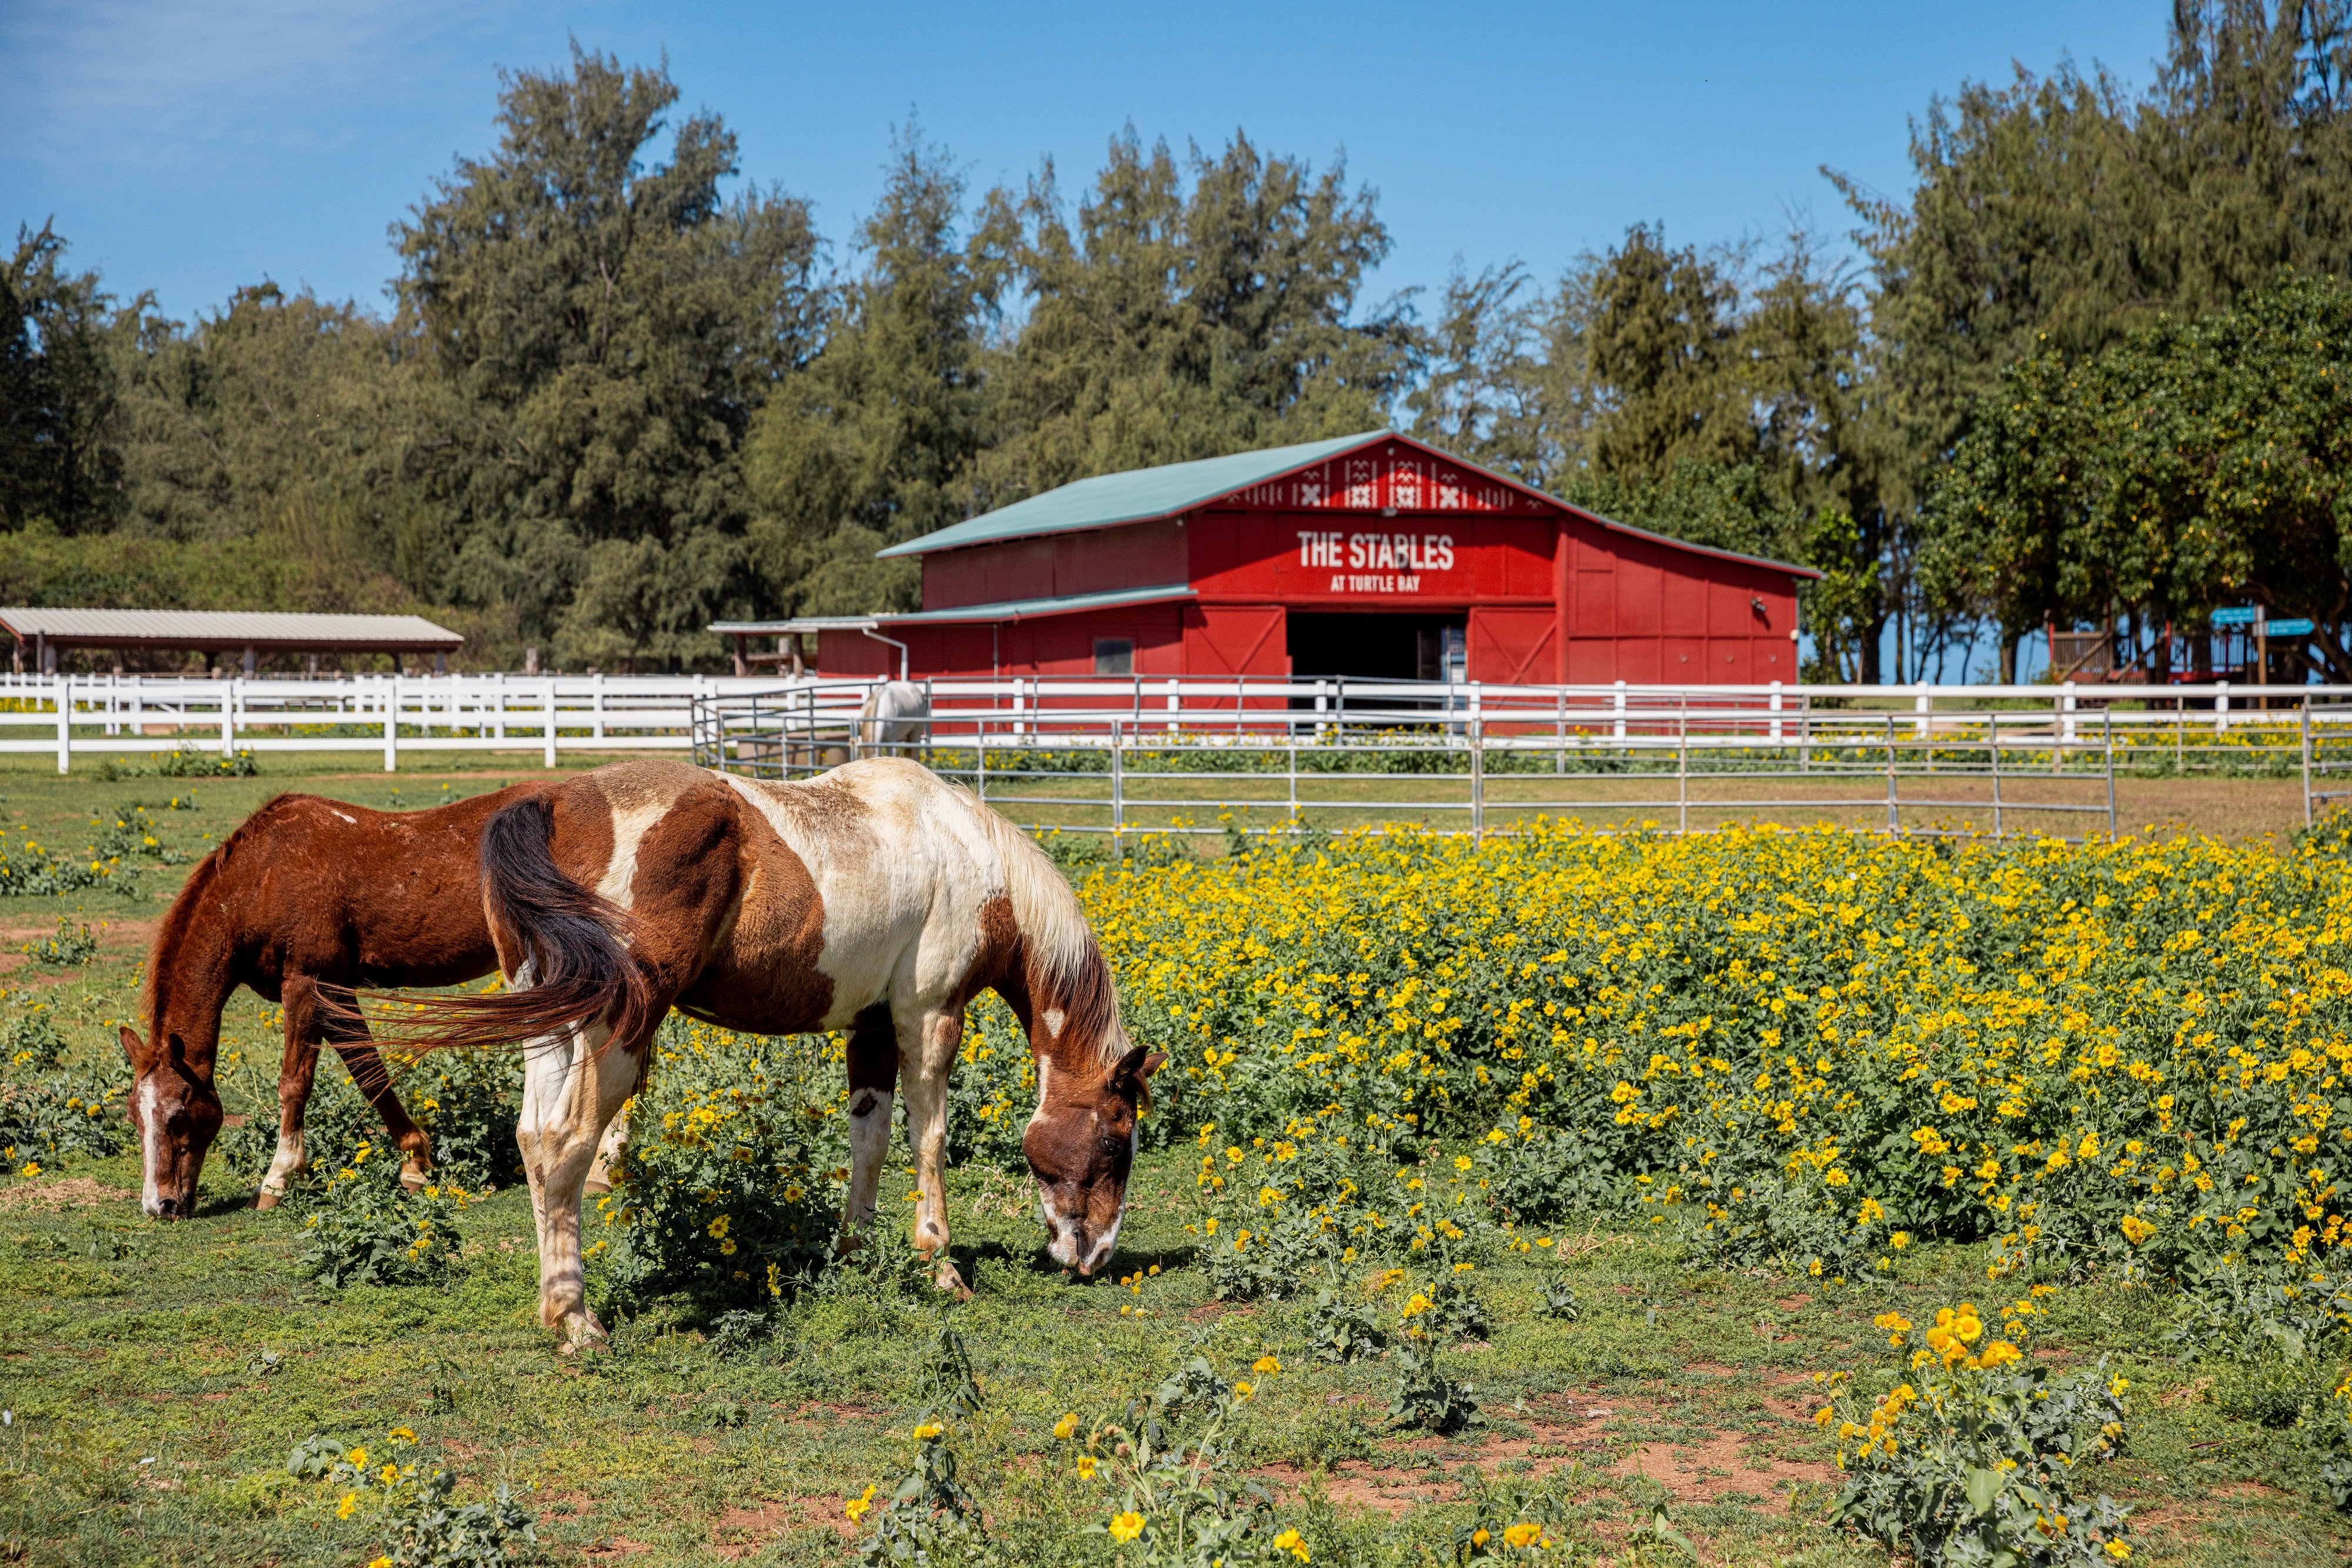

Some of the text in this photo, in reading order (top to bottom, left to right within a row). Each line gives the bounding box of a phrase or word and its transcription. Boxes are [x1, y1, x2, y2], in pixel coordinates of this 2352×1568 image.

[1297, 531, 1454, 570] THE STABLES
[1330, 575, 1420, 592] AT TURTLE BAY
